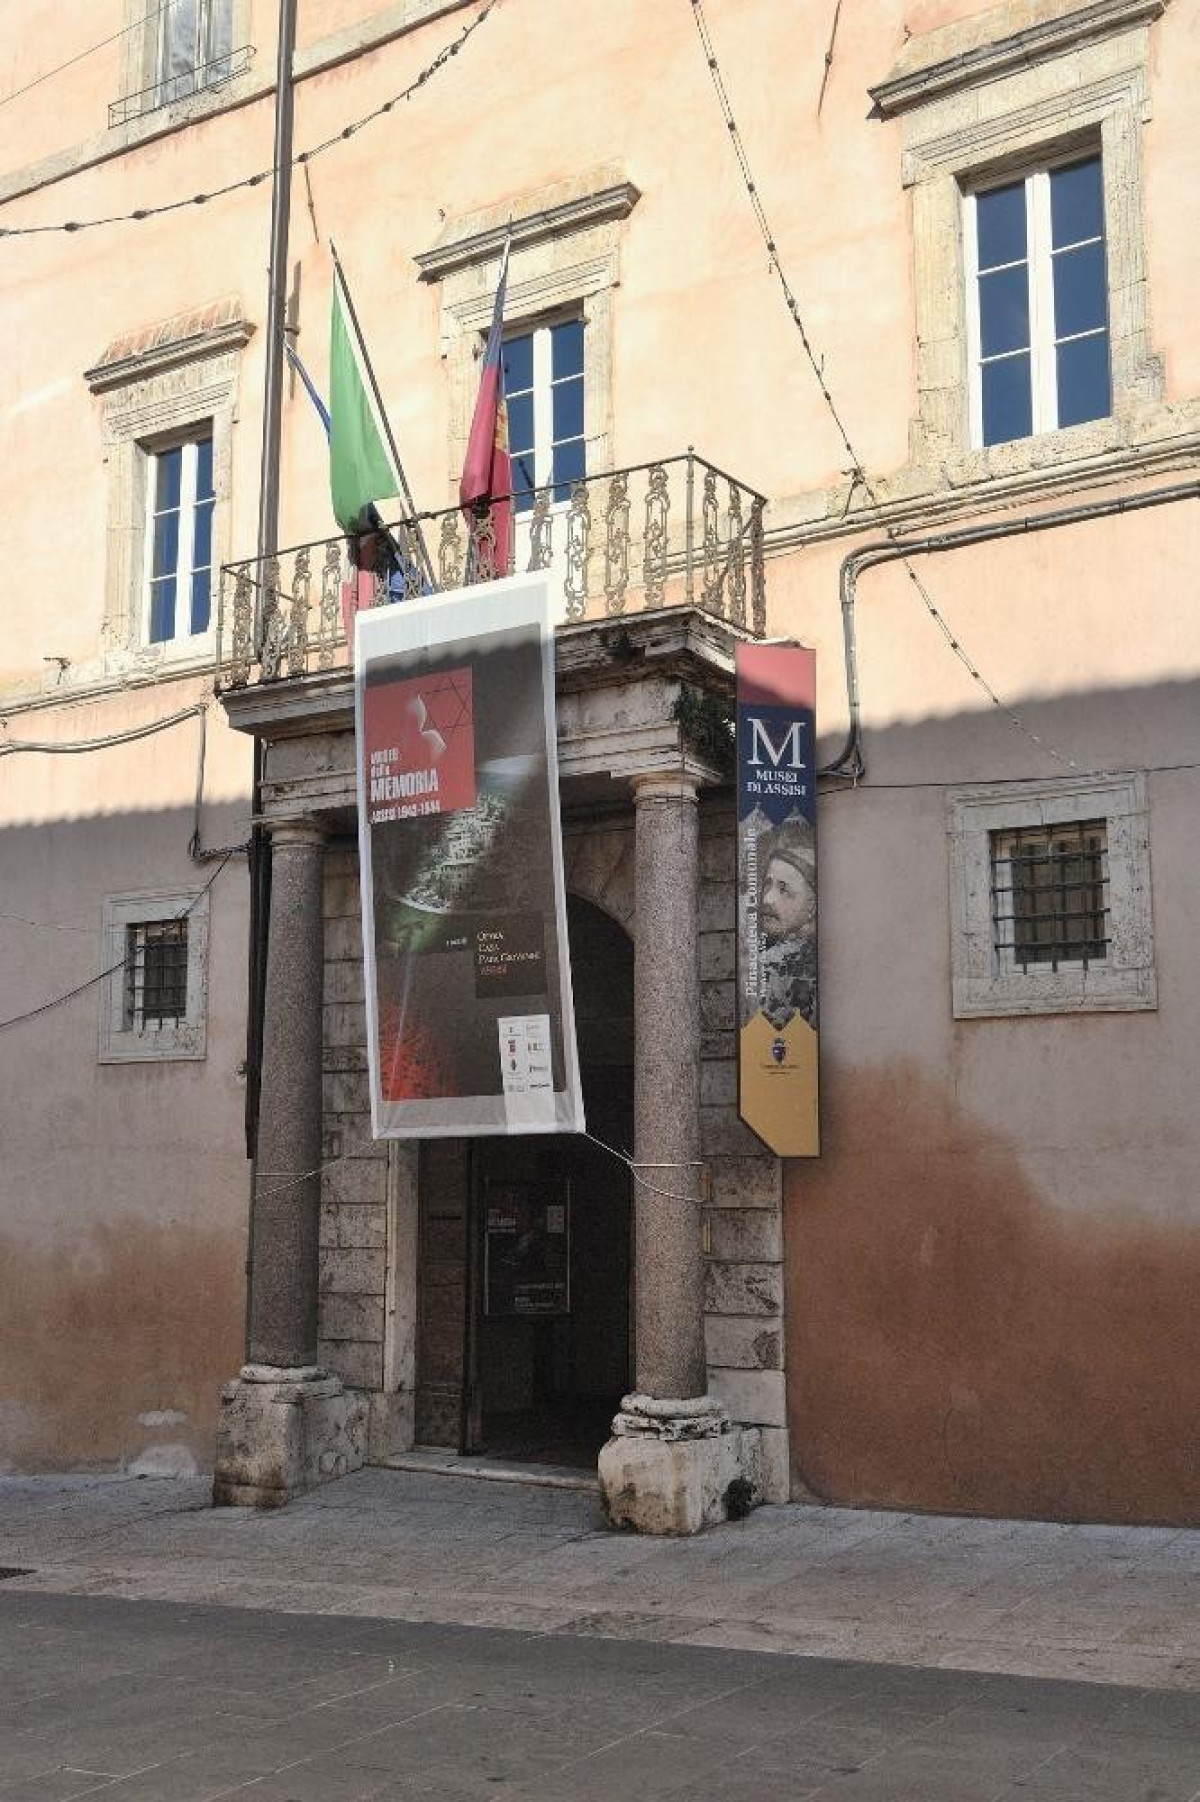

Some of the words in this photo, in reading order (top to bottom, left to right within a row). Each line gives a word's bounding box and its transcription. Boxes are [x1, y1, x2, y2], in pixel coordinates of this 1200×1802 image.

[747, 718, 807, 769] M
[371, 768, 439, 802] MEMORIA
[756, 769, 798, 783] MUSEI
[747, 781, 762, 794] DI
[764, 782, 807, 796] ASSISI
